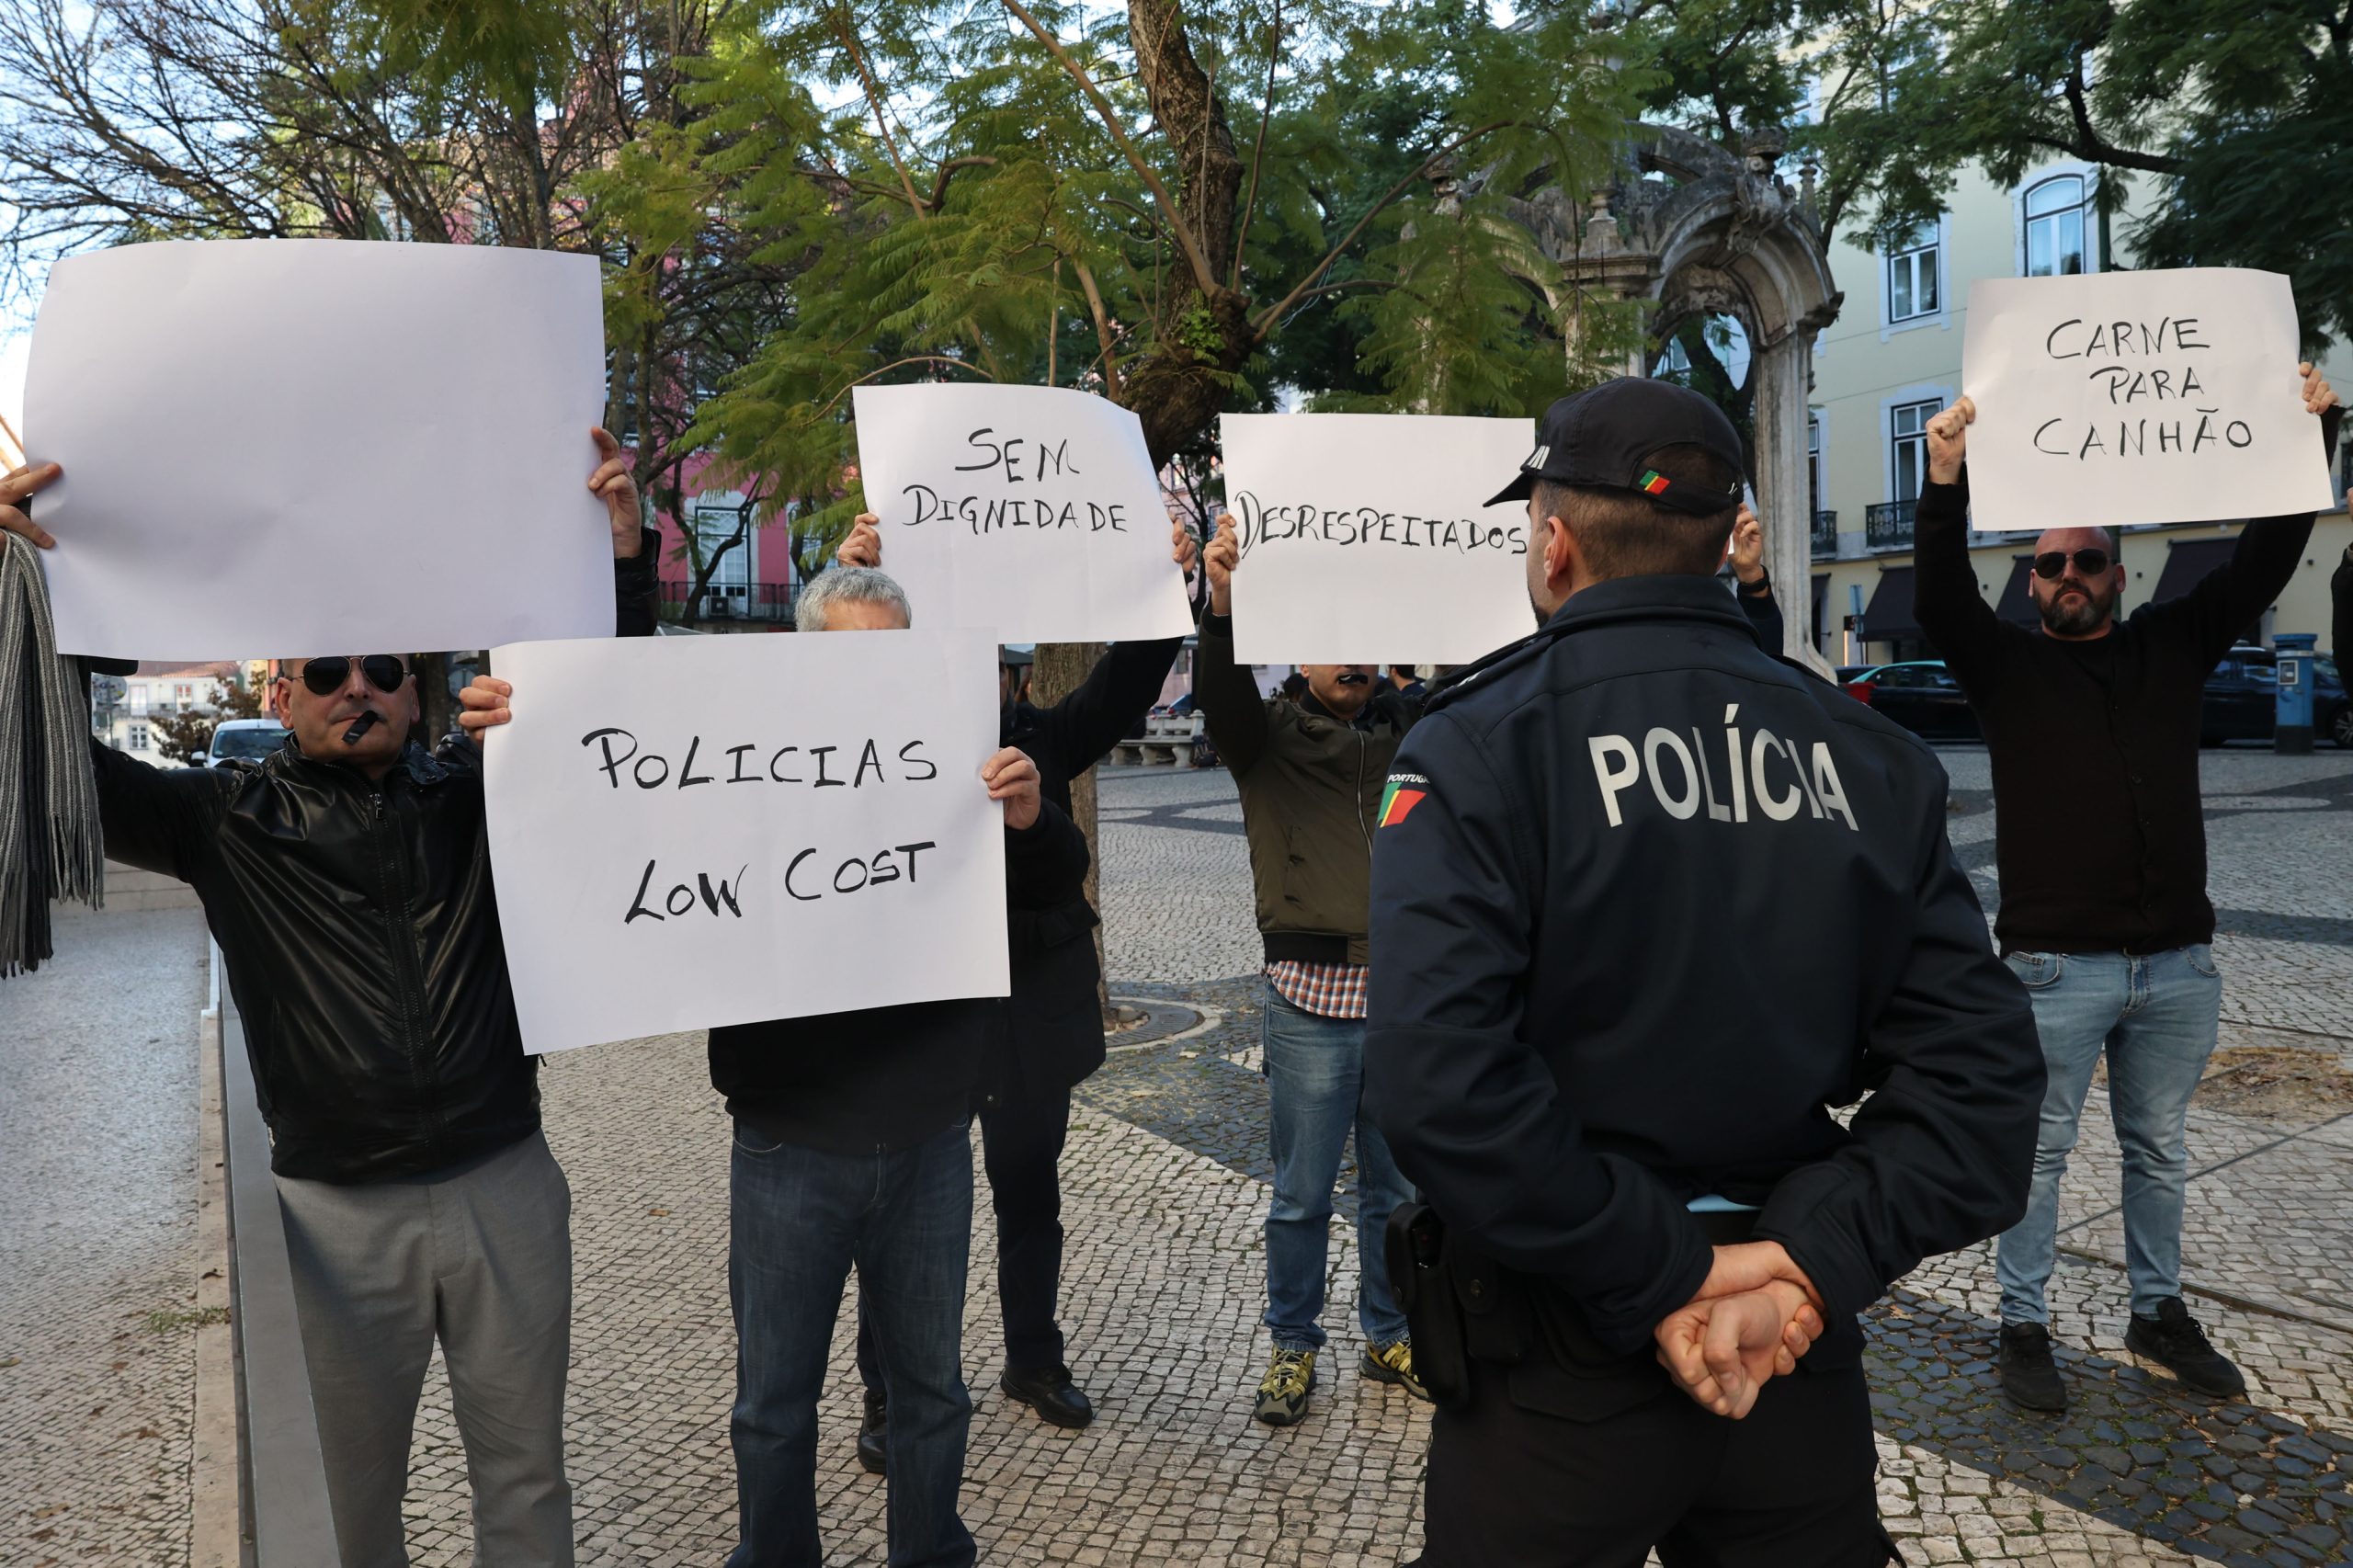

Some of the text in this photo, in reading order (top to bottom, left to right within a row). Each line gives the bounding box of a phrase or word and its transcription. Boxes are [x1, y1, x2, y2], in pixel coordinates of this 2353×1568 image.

[2046, 316, 2211, 359] CARNE
[2089, 366, 2205, 404] PARA
[954, 427, 1081, 483] SEM
[2033, 408, 2253, 460] CANHÃO
[903, 484, 1129, 536] DIGNIDADE
[1233, 490, 1528, 560] DESRESPEITADOS
[581, 727, 938, 790] POLICIAS
[1386, 773, 1431, 784] PORTUGA
[1587, 702, 1859, 832] POLÍCIA
[624, 840, 937, 925] LOW COST
